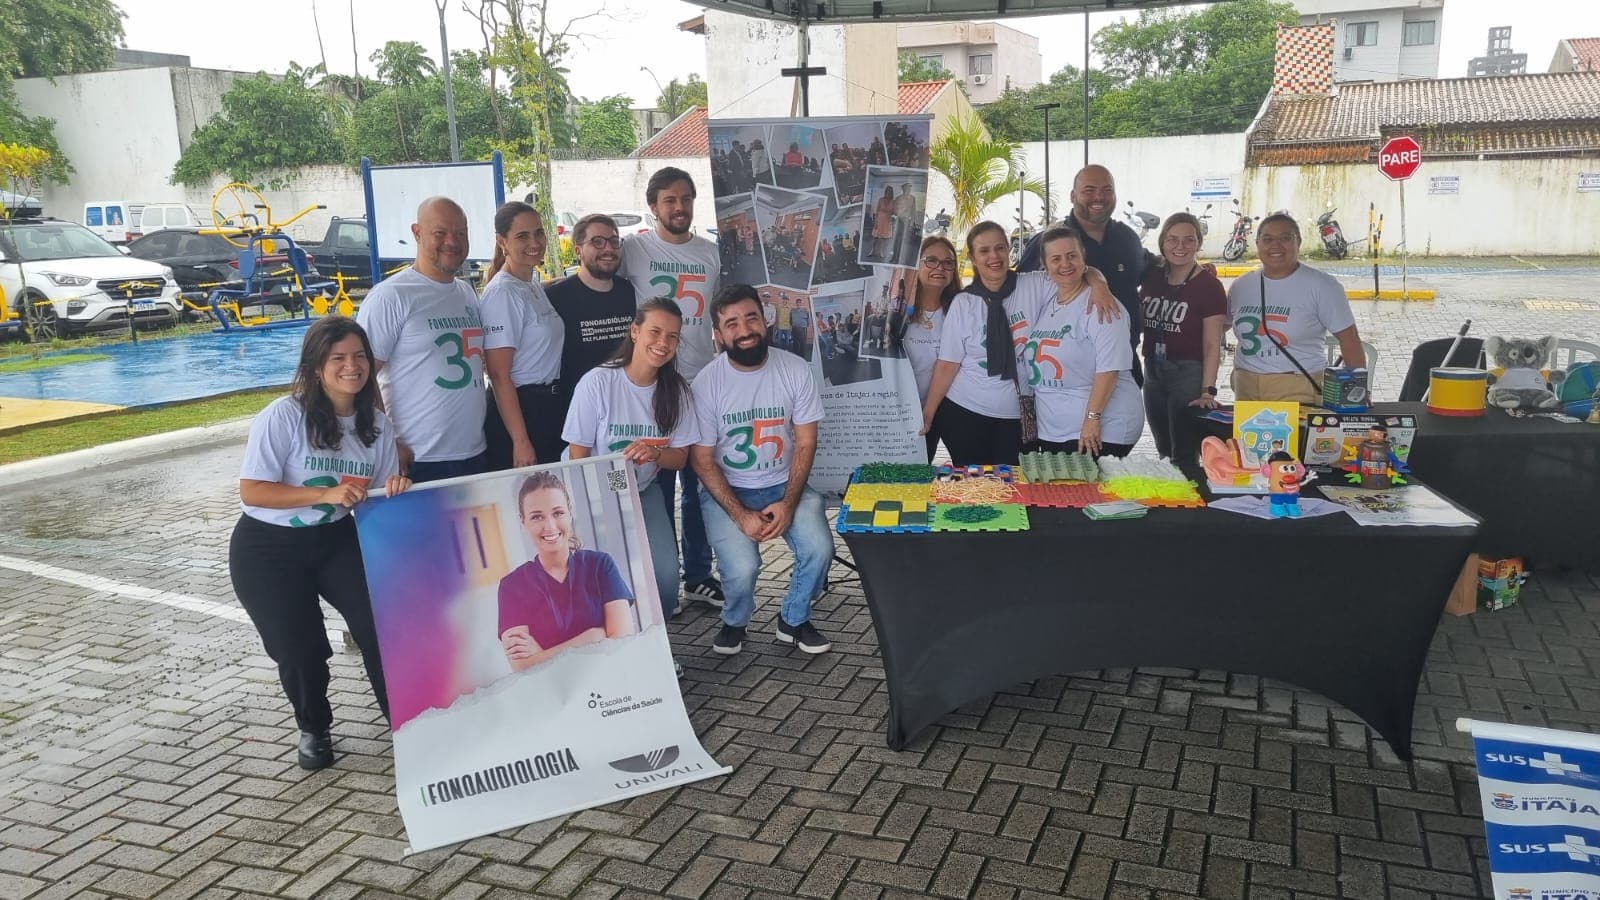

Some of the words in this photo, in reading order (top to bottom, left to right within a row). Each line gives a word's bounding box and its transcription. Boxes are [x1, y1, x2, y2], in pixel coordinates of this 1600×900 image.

[1382, 150, 1418, 167] PARE
[649, 261, 706, 274] FONOAUDIOLOGIA
[684, 317, 703, 326] NOS
[1235, 316, 1288, 356] 35
[722, 406, 785, 425] FONOAUDIOLOGIA
[722, 418, 785, 470] 35
[600, 697, 622, 708] Escola
[601, 706, 632, 717] Ciências
[641, 697, 663, 708] Saúde
[1485, 753, 1527, 766] SUS
[427, 747, 581, 805] FONOAUDIOLOGIA
[613, 762, 704, 790] UNIVALI
[1499, 843, 1547, 854] SUS
